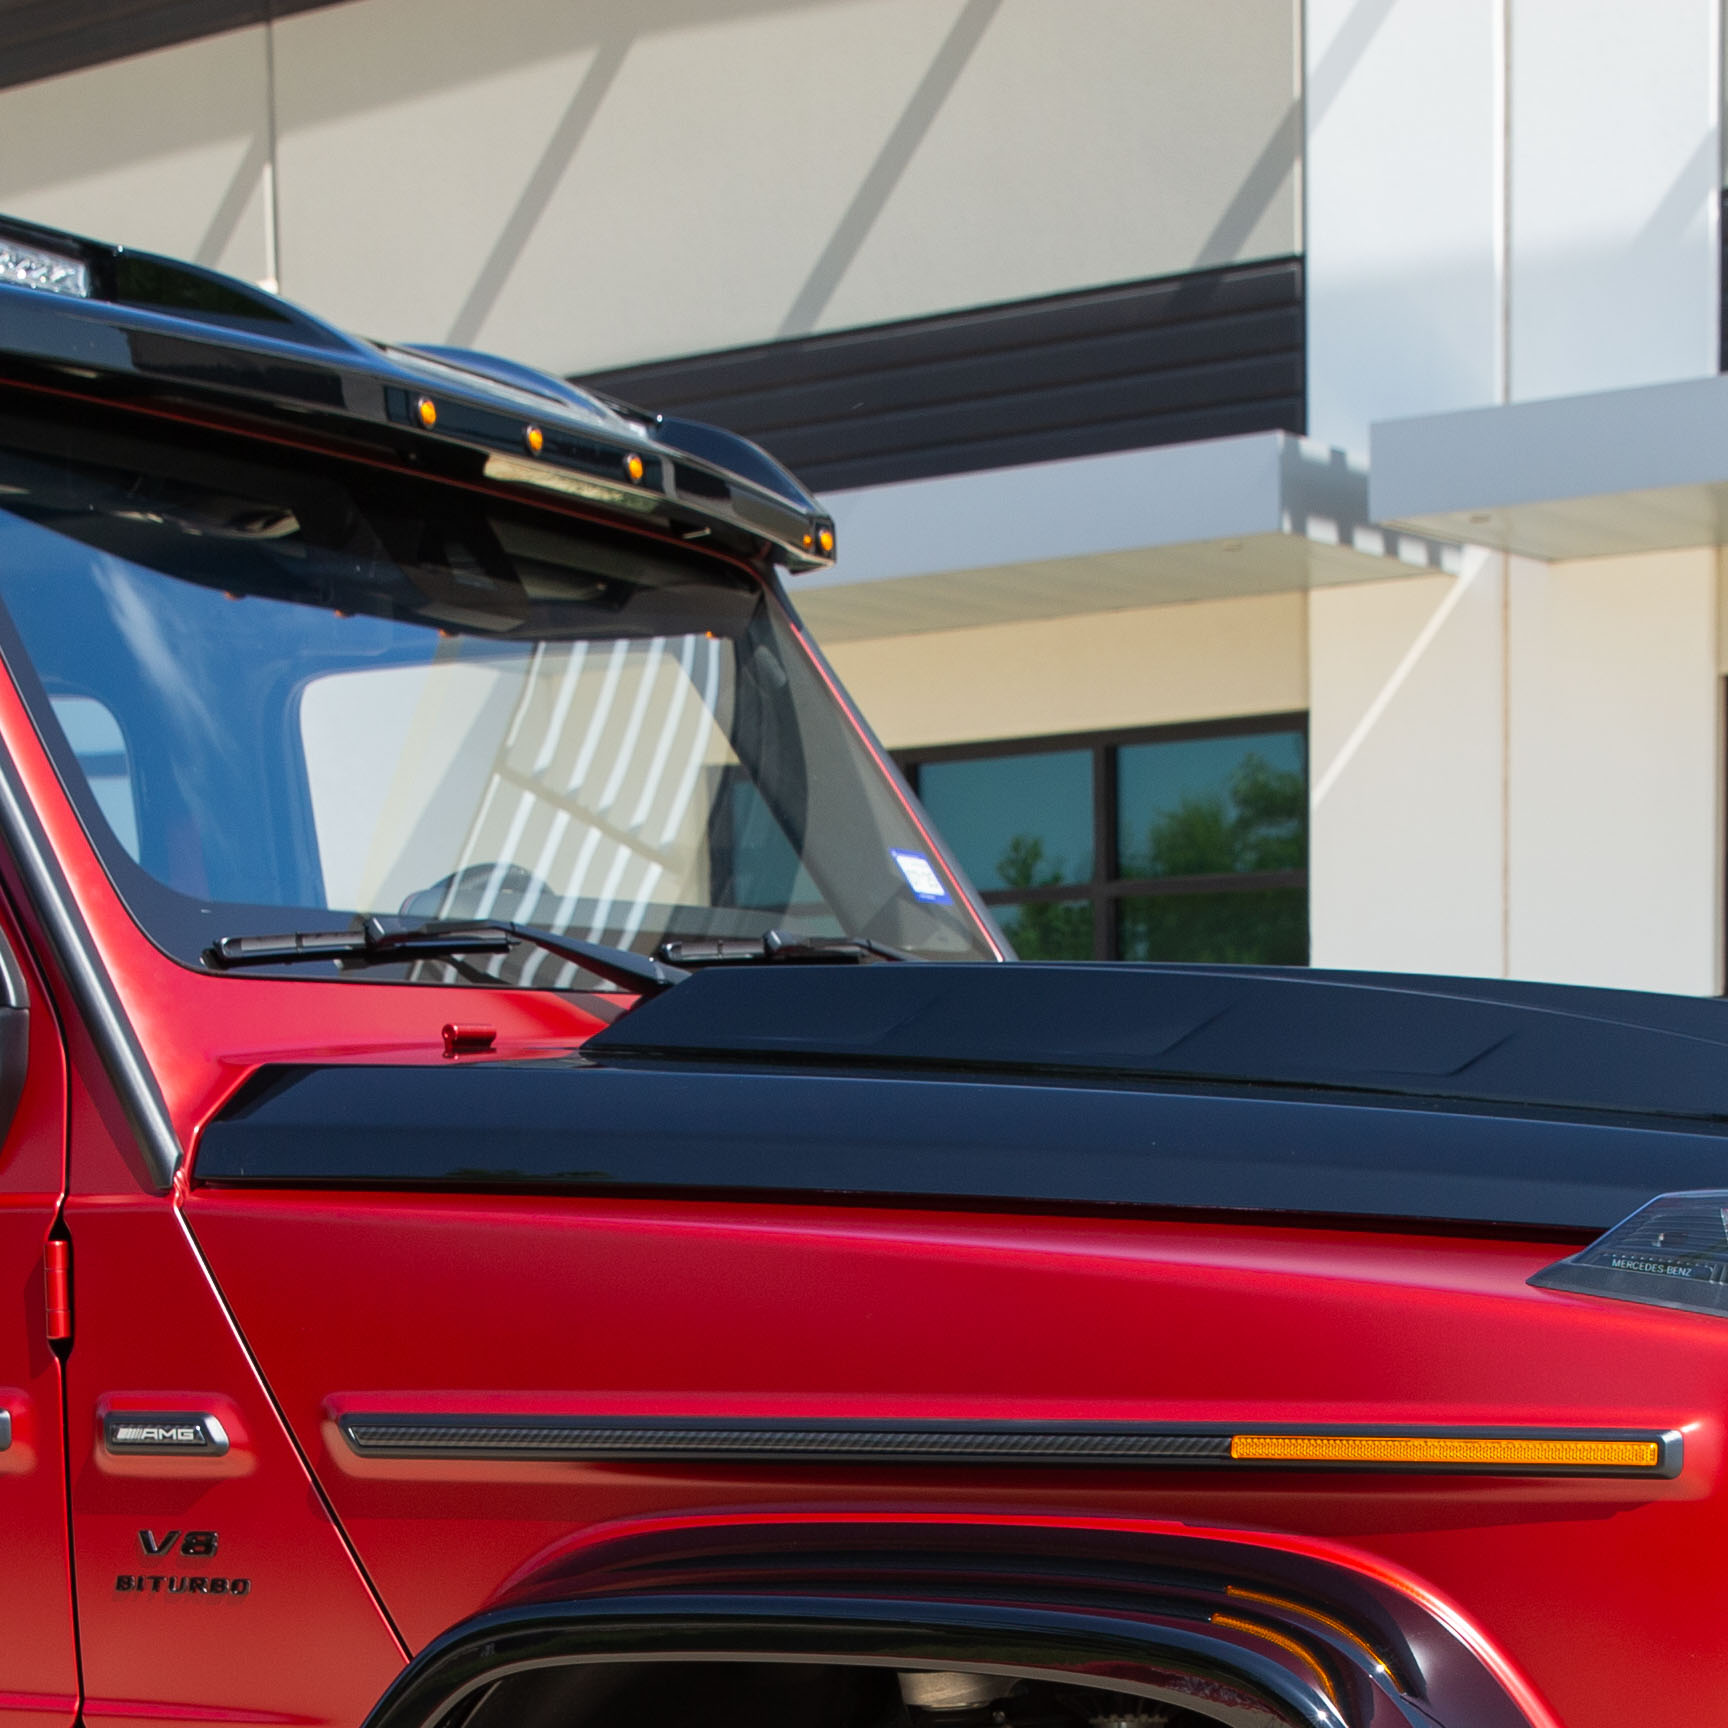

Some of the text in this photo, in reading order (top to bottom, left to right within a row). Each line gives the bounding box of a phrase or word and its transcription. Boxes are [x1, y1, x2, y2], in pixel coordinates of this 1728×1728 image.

[1611, 1258, 1693, 1278] MERCEDES-BENZ
[140, 1426, 195, 1441] AMG
[137, 1528, 219, 1558] V8
[115, 1574, 252, 1596] BITURBO
